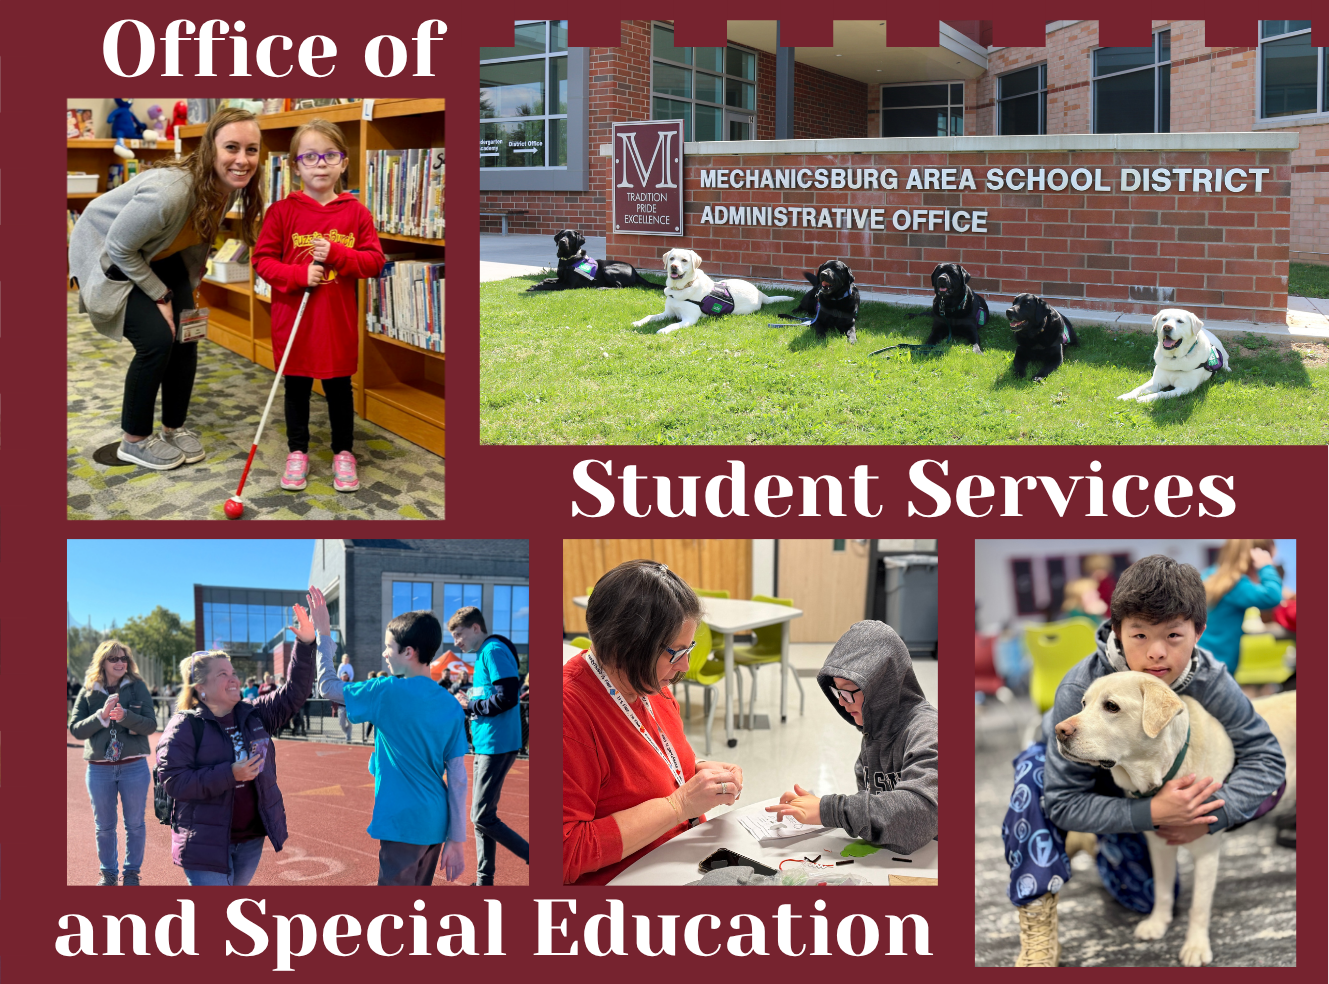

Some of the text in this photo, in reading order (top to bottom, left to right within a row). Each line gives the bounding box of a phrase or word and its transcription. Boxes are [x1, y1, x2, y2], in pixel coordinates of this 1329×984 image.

[616, 130, 678, 188] M
[700, 168, 1270, 193] MECHANICSBURG AREA SCHOOL DISTRICT
[626, 192, 668, 202] TRADITION
[636, 203, 657, 213] PRIDE
[624, 214, 670, 225] EXCELLENCE
[700, 205, 988, 233] ADMINISTRATIVE OFFICE
